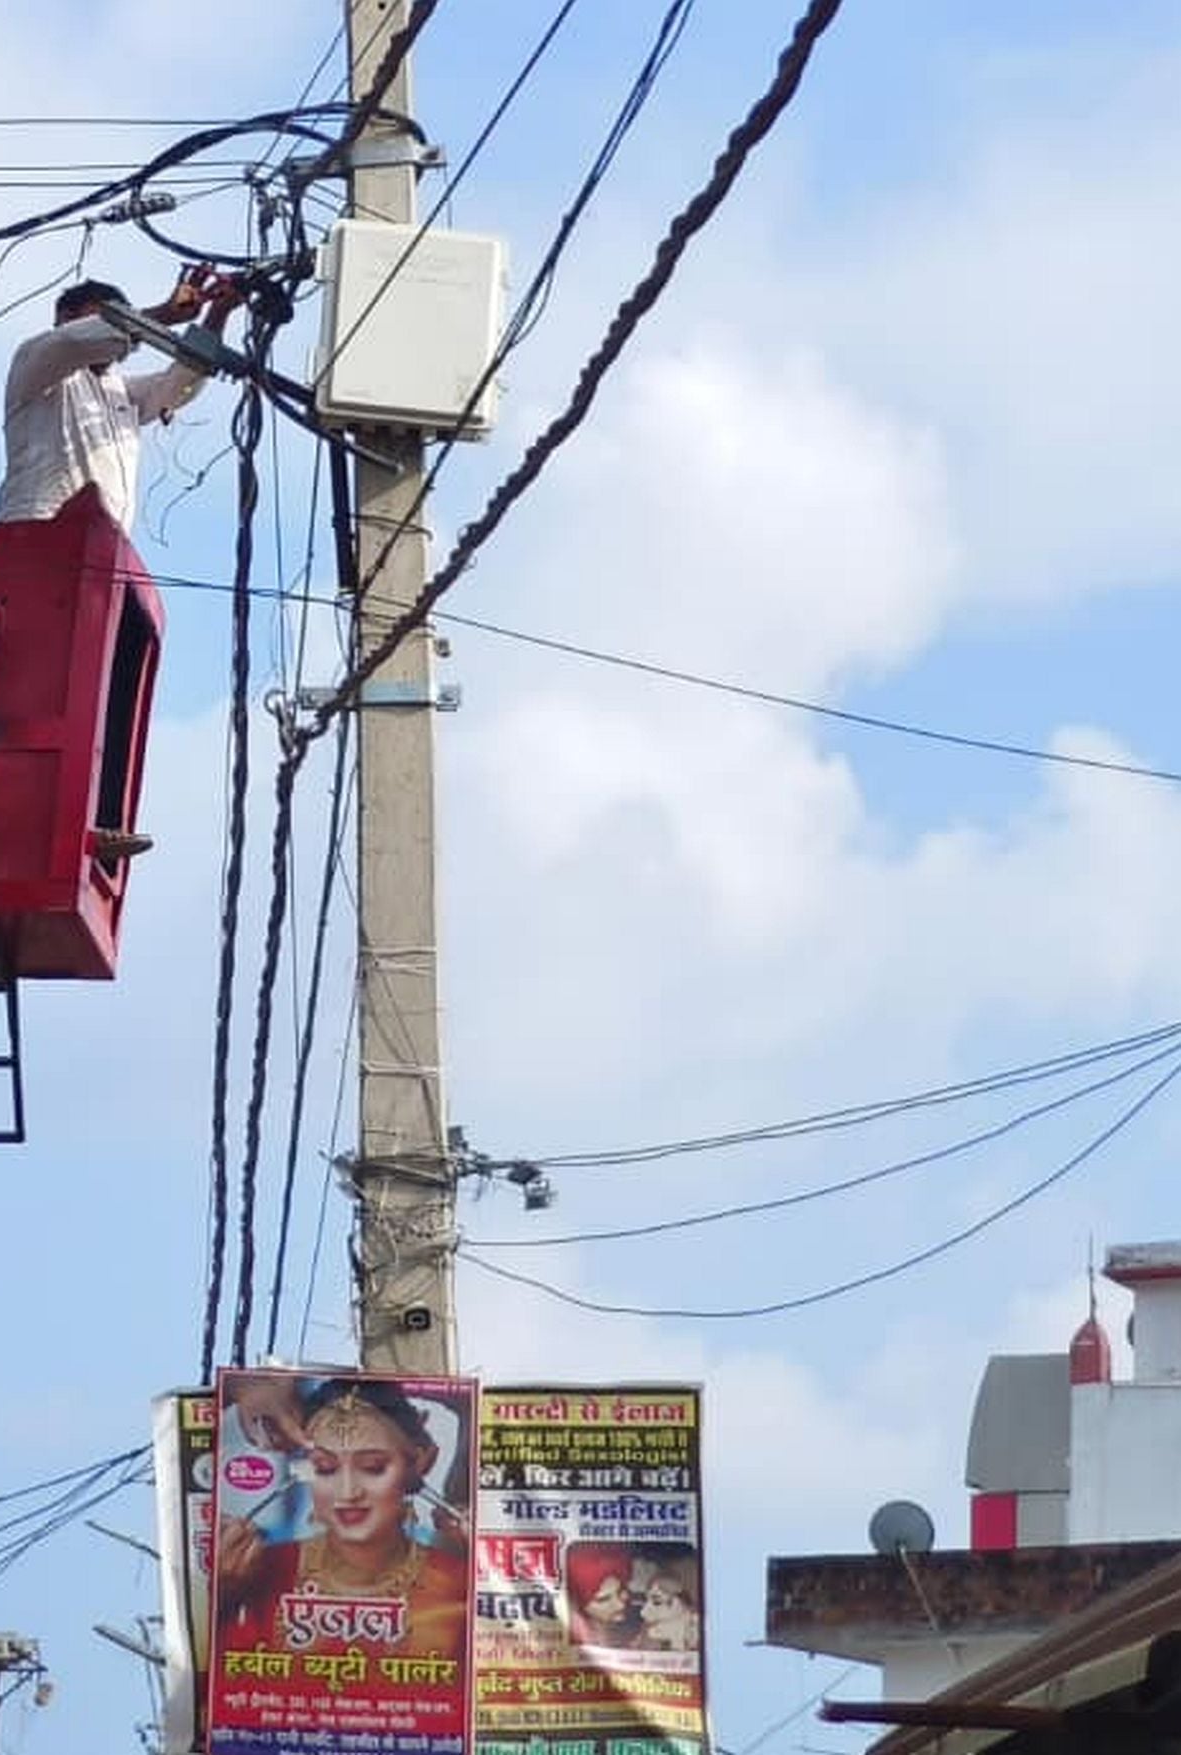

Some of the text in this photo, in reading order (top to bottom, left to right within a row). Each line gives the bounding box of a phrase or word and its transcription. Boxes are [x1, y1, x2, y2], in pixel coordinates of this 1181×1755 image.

[581, 1396, 600, 1421] से
[480, 1447, 560, 1462] ertified
[524, 1464, 572, 1487] फिर
[303, 1647, 368, 1693] ब्यूटी
